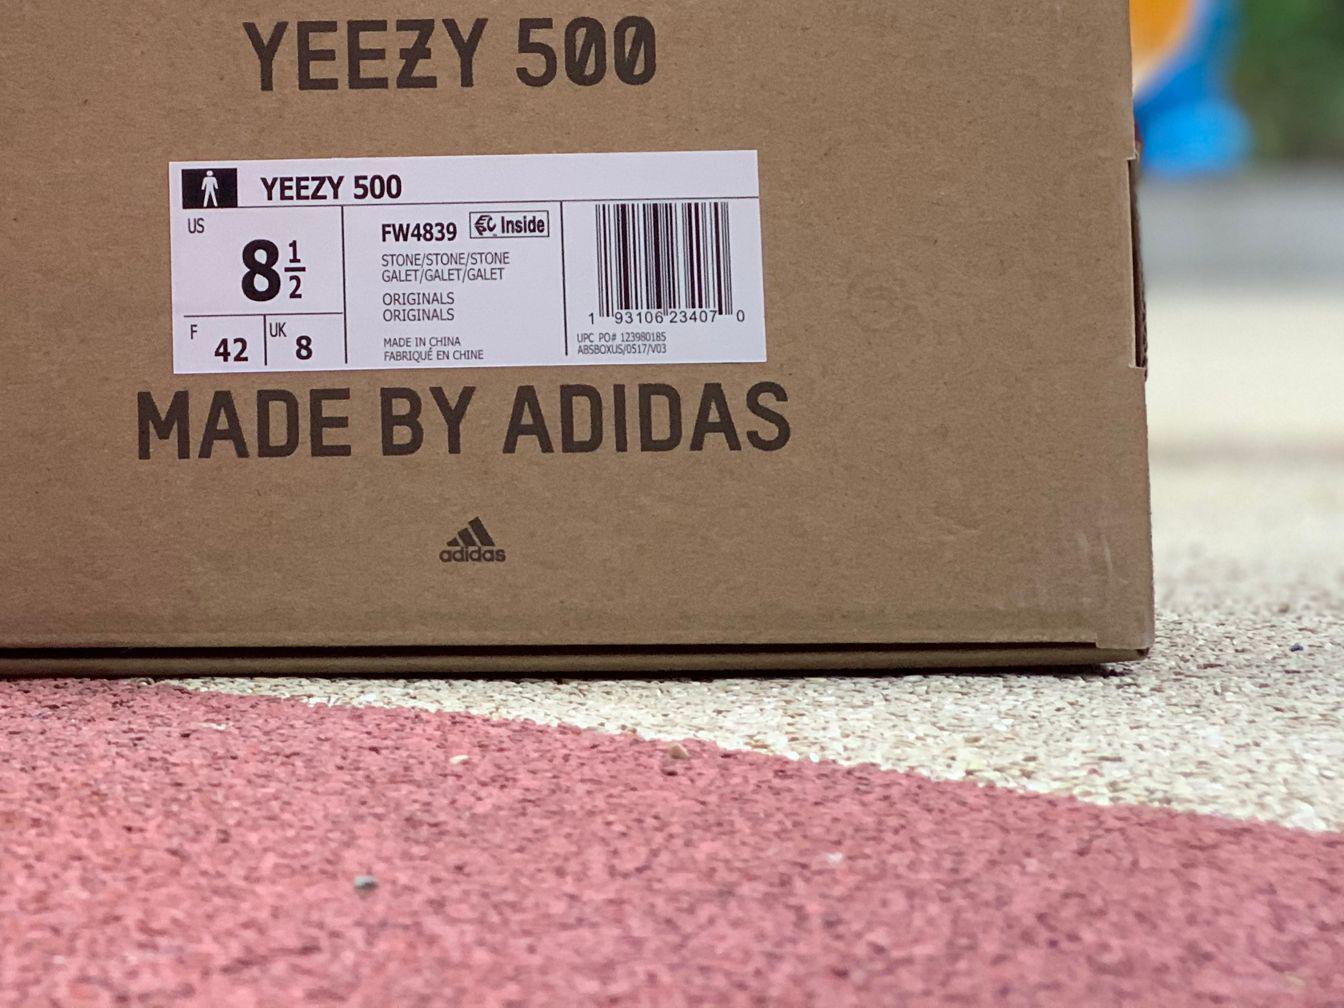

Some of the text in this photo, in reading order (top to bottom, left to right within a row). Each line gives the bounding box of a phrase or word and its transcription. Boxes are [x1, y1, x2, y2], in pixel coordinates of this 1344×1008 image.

[242, 15, 657, 92] YEEZY 500
[260, 174, 403, 201] YEEZY 500
[187, 217, 205, 234] US
[381, 222, 458, 243] FW4839
[501, 215, 545, 234] Inside
[381, 251, 511, 268] STONE/STONE/STONE
[241, 238, 281, 302] 8
[381, 267, 505, 284] GALET/GALET/GALET
[382, 291, 455, 306] ORIGINALS
[382, 308, 455, 322] ORIGINALS
[614, 311, 664, 325] 93106
[669, 309, 718, 324] 23407
[189, 323, 198, 340] F
[269, 322, 287, 338] UK
[576, 332, 594, 343] UPC
[213, 336, 250, 363] 42
[295, 335, 313, 361] 8
[383, 336, 461, 348] MADE IN CHINA
[383, 347, 484, 363] FABRIQUÉ EN CHINE
[136, 380, 792, 461] MADE BY ADIDAS
[438, 544, 507, 564] adidas
